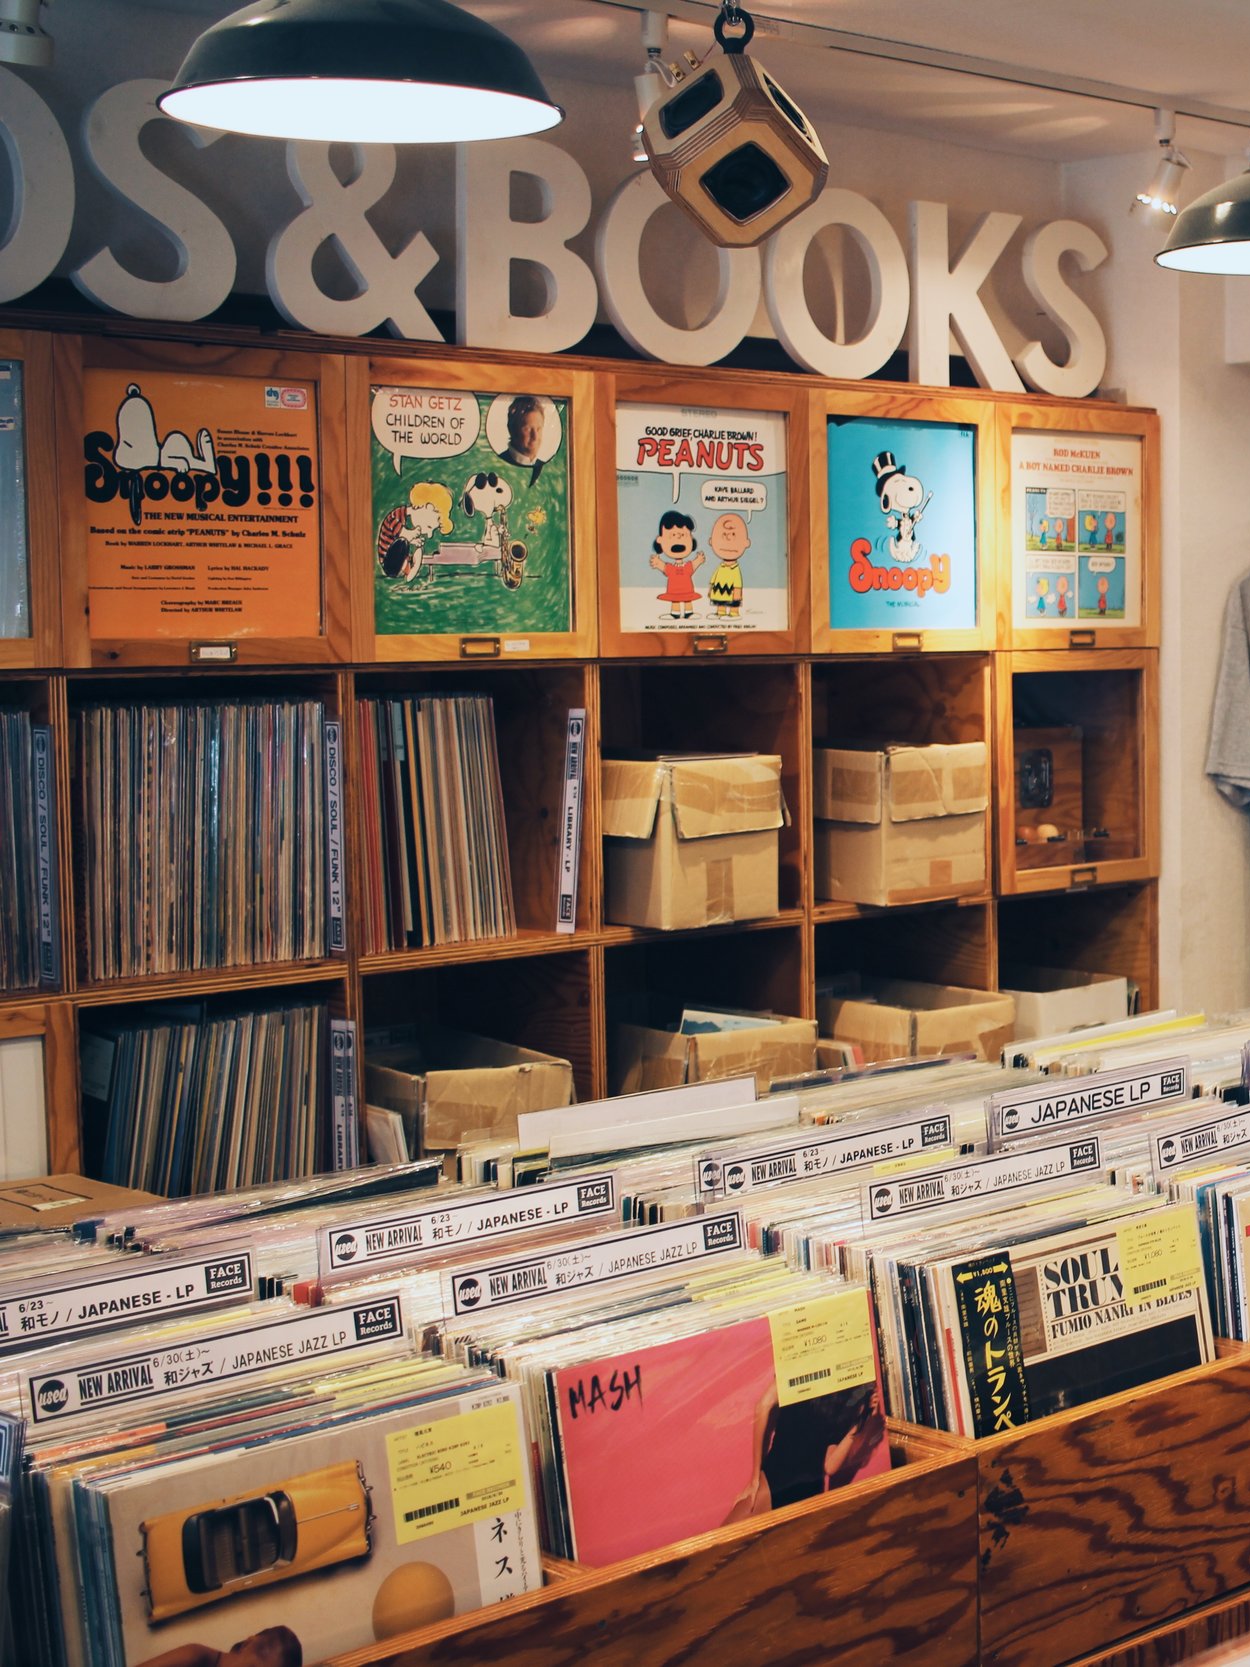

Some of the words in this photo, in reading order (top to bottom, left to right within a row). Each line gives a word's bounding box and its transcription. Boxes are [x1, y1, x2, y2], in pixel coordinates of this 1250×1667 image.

[265, 140, 448, 343] &
[455, 137, 1108, 399] BOOKS
[389, 393, 423, 409] STAN
[428, 395, 462, 411] GETZ
[386, 413, 445, 429] CHILDREN
[450, 415, 466, 430] OF
[391, 430, 414, 444] THE
[420, 432, 462, 446] WORLD
[645, 426, 669, 436] GOOD
[693, 429, 726, 440] CHARLIE
[636, 437, 764, 471] PEANUTS
[1053, 448, 1069, 457] ROD
[1026, 462, 1042, 471] BOY
[1042, 463, 1070, 473] NAMED
[1071, 465, 1105, 475] CHARLIE
[1106, 467, 1134, 476] BROWN
[144, 512, 162, 520] THE
[164, 512, 185, 520] NEW
[186, 513, 225, 522] MUSICAL
[228, 514, 298, 523] ENTERTAINMENT
[143, 528, 165, 536] comic
[168, 528, 185, 537] strip
[231, 530, 240, 538] by
[850, 538, 951, 598] Snoopy
[329, 746, 338, 787] DISCO
[37, 756, 46, 800] DISCO
[330, 799, 339, 835] SOUL
[39, 815, 48, 853] SOUL
[566, 806, 574, 851] LIBRARY
[331, 848, 340, 885] FUNK
[565, 859, 572, 873] LP
[41, 867, 49, 905] FUNK
[1163, 1073, 1181, 1086] FACE
[1031, 1087, 1125, 1124] JAPANESE
[1130, 1082, 1151, 1101] LP
[924, 1122, 945, 1136] FACE
[924, 1132, 946, 1144] Records
[1223, 1127, 1248, 1145] 和ジャズ
[336, 1124, 344, 1170] LIBRARY
[839, 1144, 893, 1164] JAPANESE
[902, 1138, 915, 1151] LP
[1072, 1145, 1094, 1158] FACE
[1181, 1136, 1195, 1154] NEW
[1195, 1129, 1218, 1151] ARRIVAL
[752, 1162, 767, 1182] NEW
[768, 1156, 797, 1178] ARRIVAL
[804, 1155, 828, 1173] 和モノ
[1073, 1154, 1095, 1166] Records
[993, 1168, 1033, 1187] JAPANESE
[1034, 1164, 1053, 1178] JAZZ
[1055, 1161, 1066, 1173] LP
[580, 1184, 606, 1199] FACE
[899, 1187, 915, 1205] NEW
[916, 1180, 945, 1200] ARRIVAL
[951, 1180, 983, 1196] 和ジャズ
[581, 1195, 607, 1208] Records
[477, 1206, 544, 1231] JAPANESE
[554, 1201, 569, 1215] LP
[366, 1231, 385, 1252] NEW
[387, 1224, 423, 1248] ARRIVAL
[432, 1223, 463, 1240] 和モノ
[707, 1222, 733, 1237] FACE
[708, 1232, 734, 1246] Records
[334, 1241, 358, 1256] used
[608, 1251, 657, 1274] JAPANESE
[660, 1245, 683, 1262] JAZZ
[686, 1241, 698, 1255] LP
[209, 1263, 242, 1279] FACE
[555, 1265, 594, 1286] 和ジャズ
[1043, 1247, 1120, 1290] SOUL
[210, 1276, 243, 1291] Records
[458, 1284, 482, 1300] used
[489, 1277, 509, 1297] NEW
[512, 1269, 548, 1291] ARRIVAL
[78, 1289, 162, 1321] JAPANESE
[175, 1284, 195, 1299] LP
[21, 1311, 59, 1332] 和モノ
[358, 1306, 392, 1325] FACE
[1051, 1316, 1092, 1339] FUMIO
[1156, 1289, 1193, 1308] BLUES
[359, 1320, 394, 1337] Records
[232, 1342, 294, 1370] JAPANESE
[298, 1335, 329, 1354] JAZZ
[331, 1330, 348, 1347] LP
[804, 1335, 827, 1347] ¥1,080
[78, 1375, 104, 1401] NEW
[107, 1363, 153, 1395] ARRIVAL
[163, 1361, 215, 1387] 和ジャズ
[38, 1386, 69, 1407] used
[567, 1364, 644, 1420] MASH
[430, 1460, 452, 1474] ¥540
[460, 1503, 488, 1517] JAPANESE
[489, 1499, 502, 1509] JAZZ
[503, 1496, 510, 1505] LP
